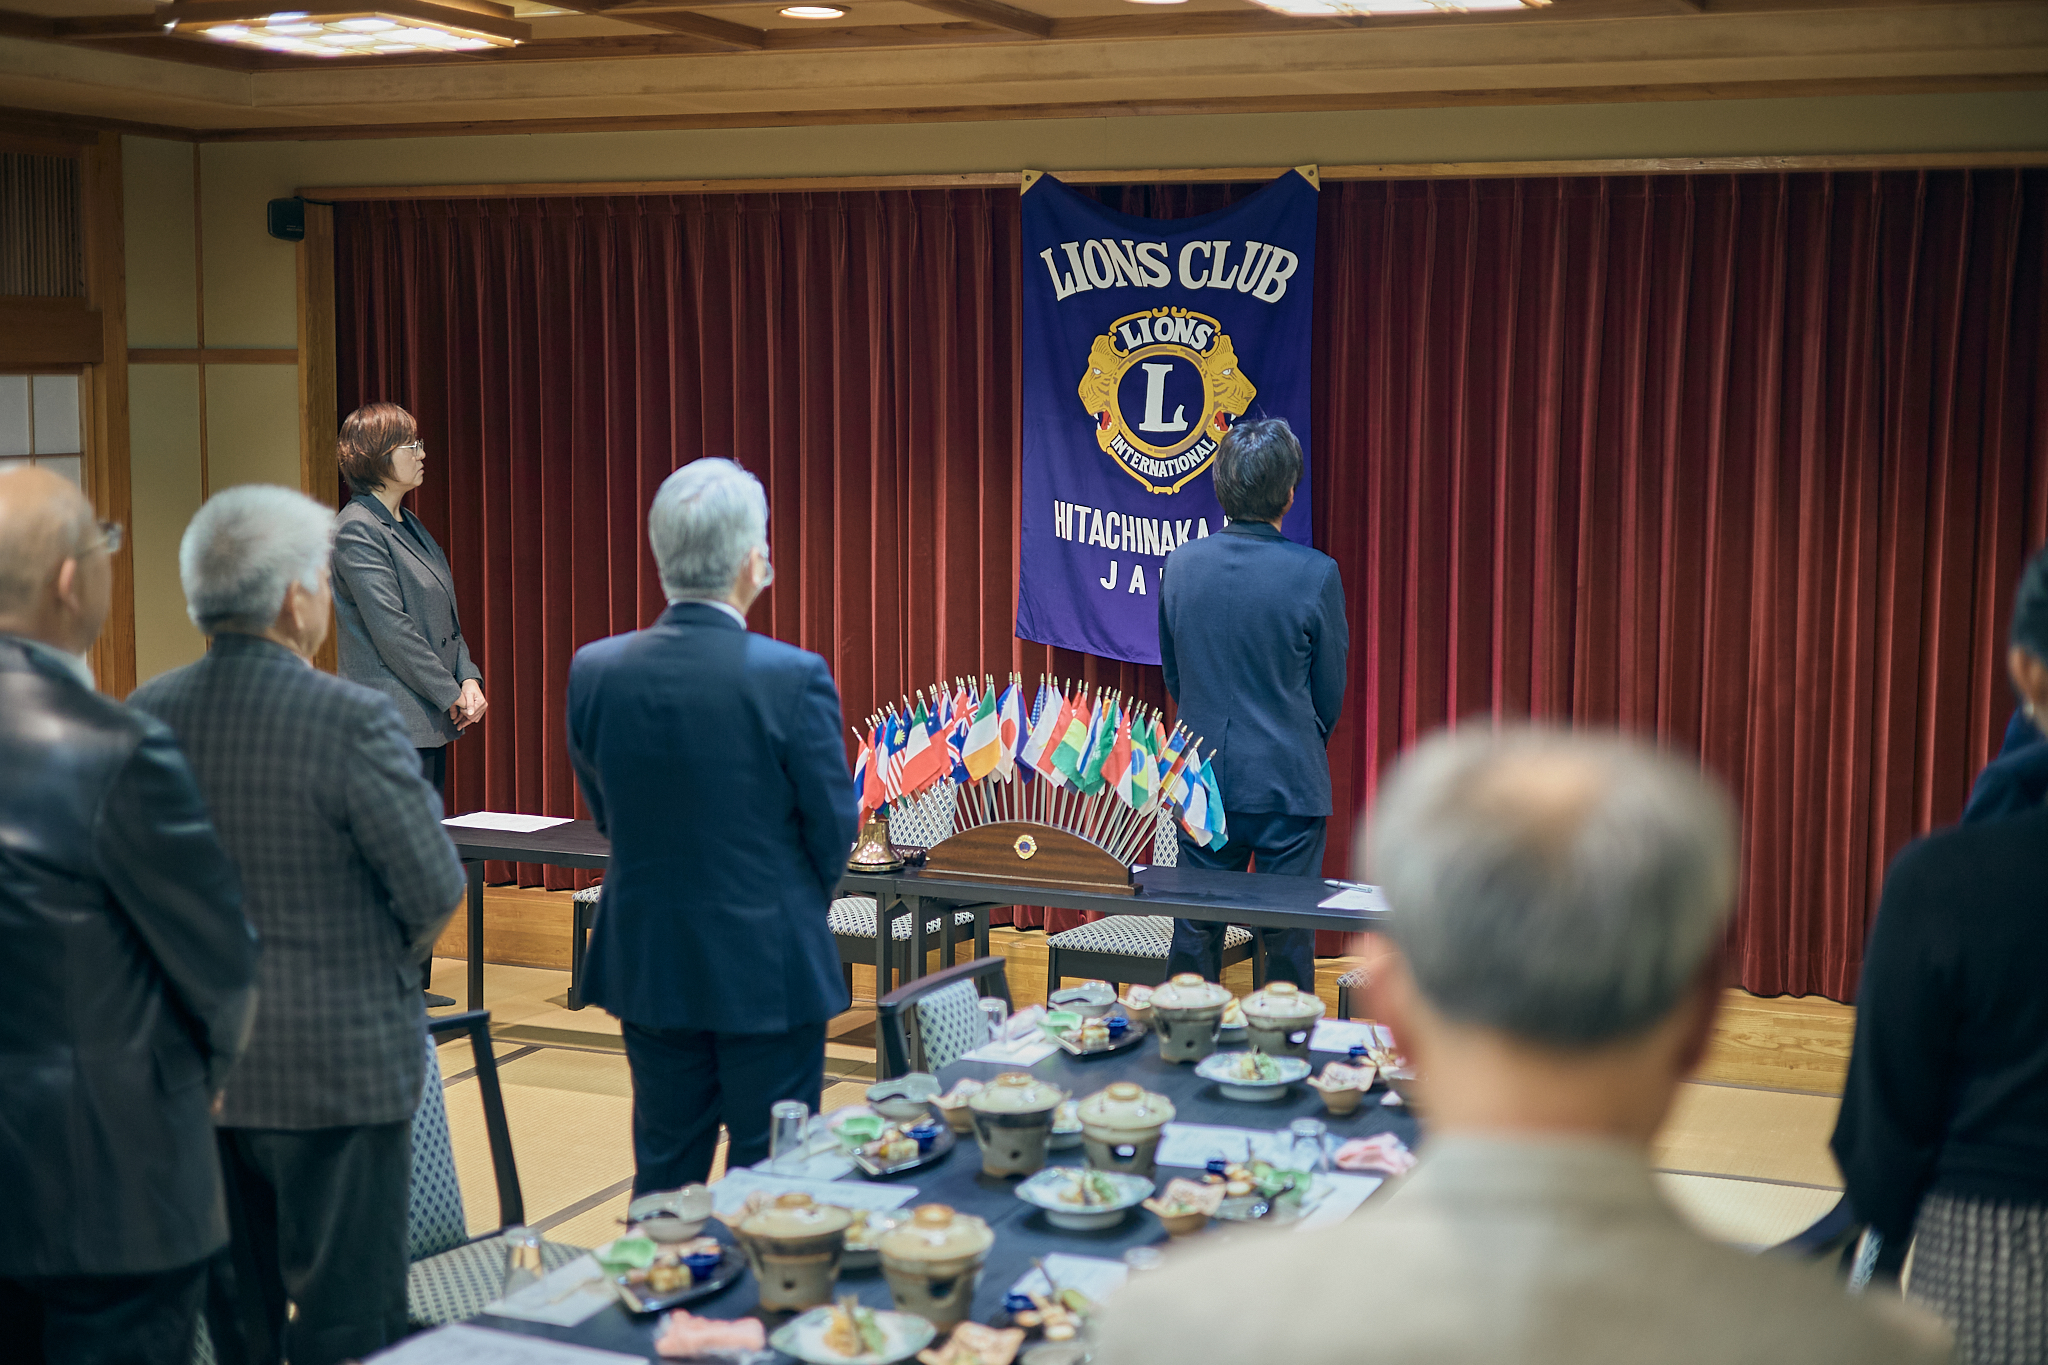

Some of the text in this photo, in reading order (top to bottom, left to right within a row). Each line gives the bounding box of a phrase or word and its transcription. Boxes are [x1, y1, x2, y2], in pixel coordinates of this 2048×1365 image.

[1040, 238, 1299, 303] LIONS CLUB
[1118, 316, 1214, 350] LIONS
[1138, 362, 1189, 432] L
[1110, 434, 1217, 478] INTERNATIONAL
[1054, 499, 1210, 557] HITACHINAKA
